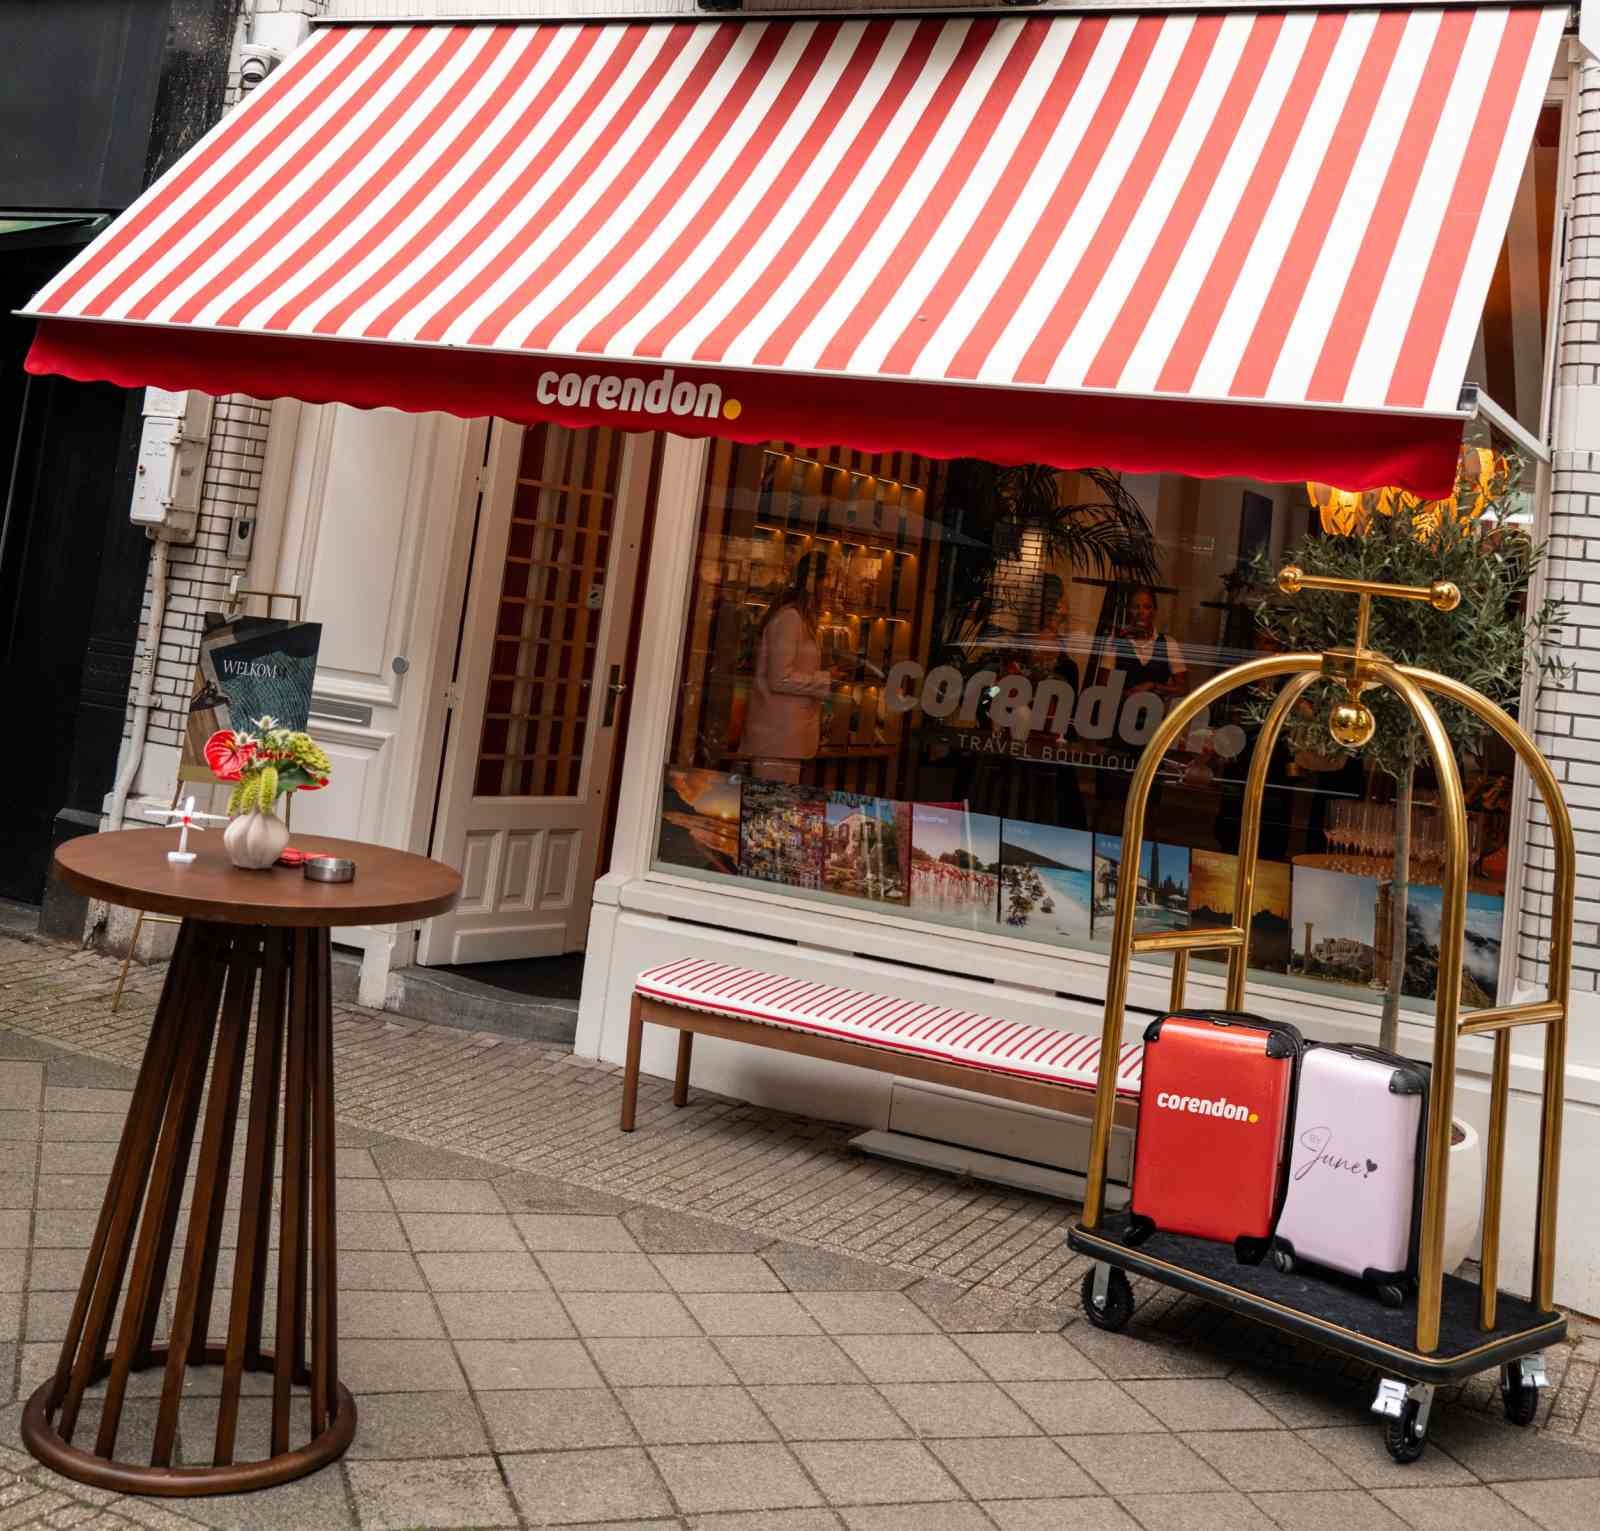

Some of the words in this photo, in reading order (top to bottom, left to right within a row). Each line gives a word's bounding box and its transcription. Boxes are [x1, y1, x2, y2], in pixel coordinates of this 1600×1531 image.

[536, 368, 742, 420] corendon.
[223, 658, 278, 680] WELKOM
[958, 733, 1034, 757] TRAVEL
[1156, 1092, 1259, 1123] corendon.
